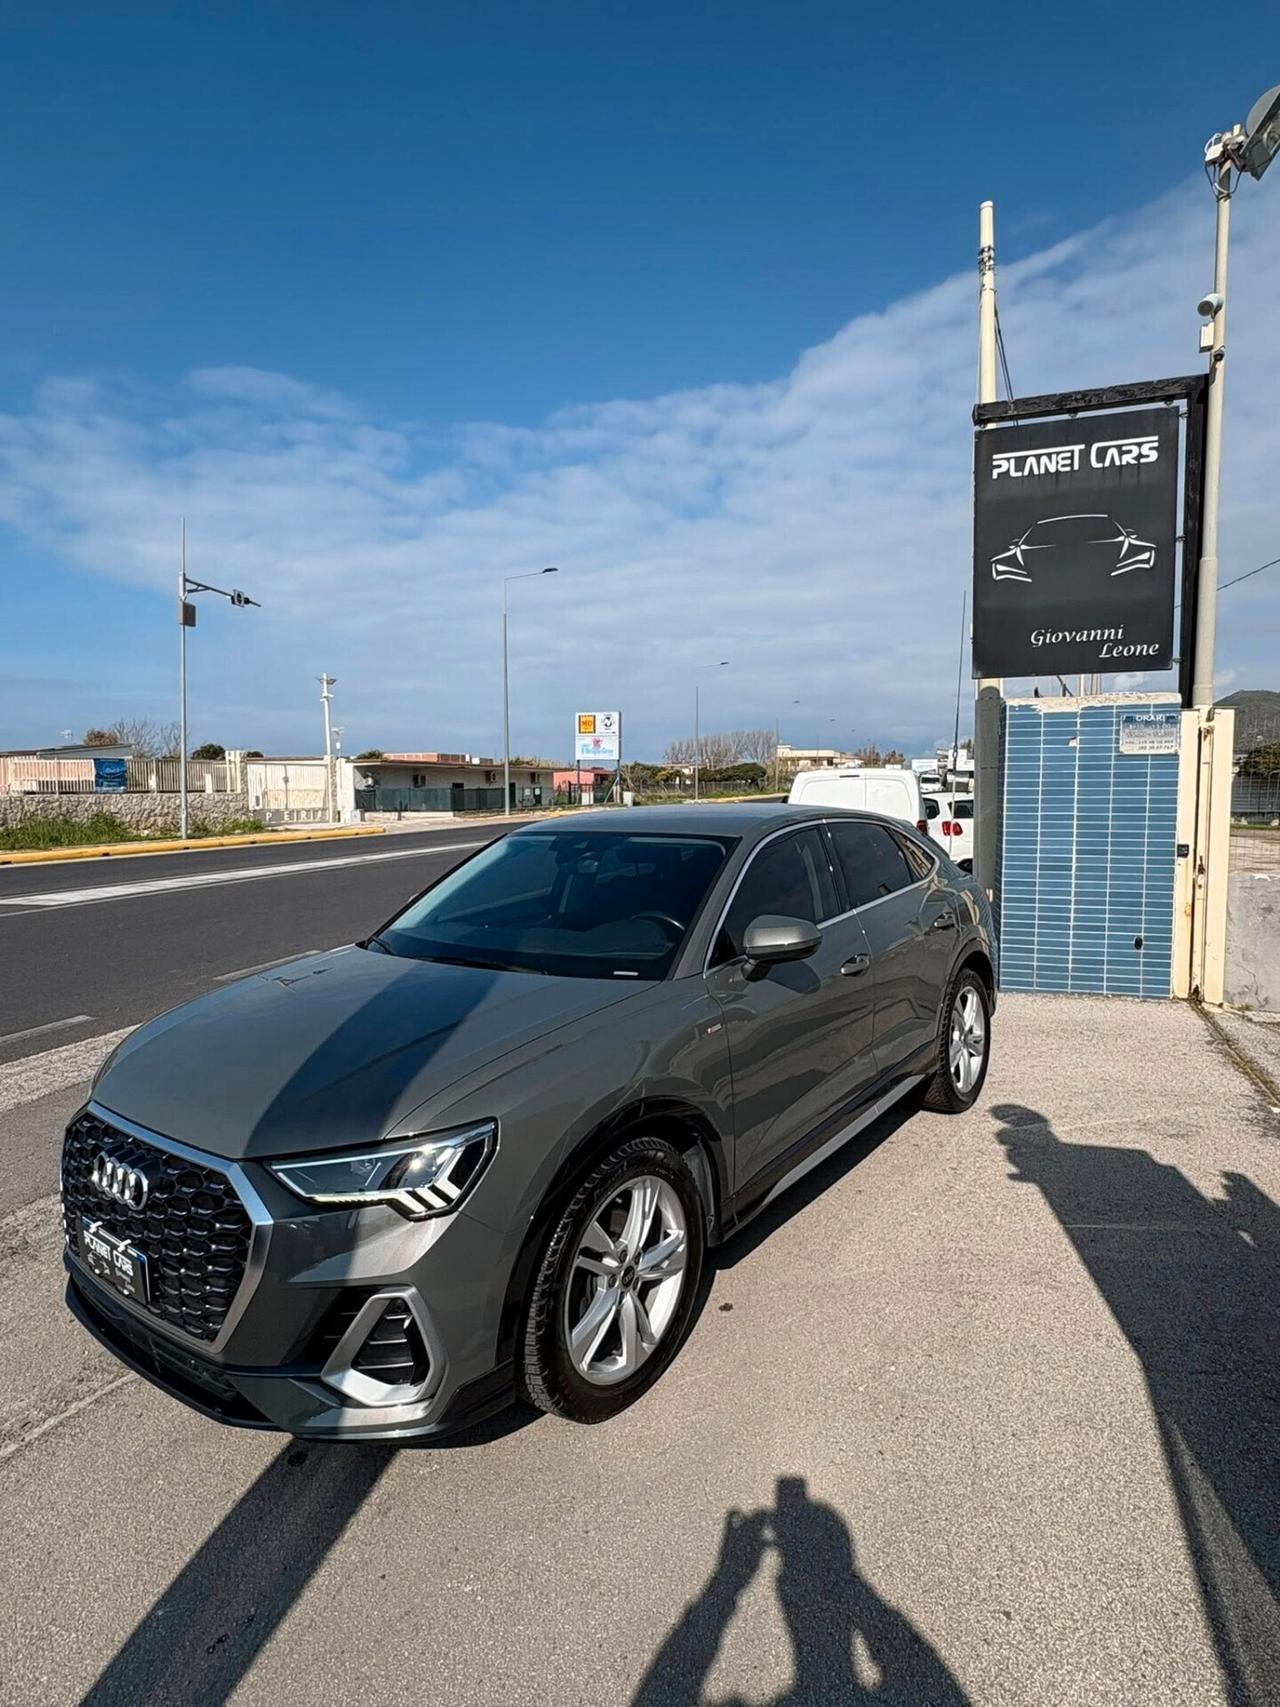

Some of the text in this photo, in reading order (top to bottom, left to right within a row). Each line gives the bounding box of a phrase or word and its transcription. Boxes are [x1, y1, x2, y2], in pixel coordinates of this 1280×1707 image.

[992, 435, 1159, 479] PLANET CARS
[1030, 624, 1124, 648] Giovanni
[1098, 641, 1160, 658] Leone
